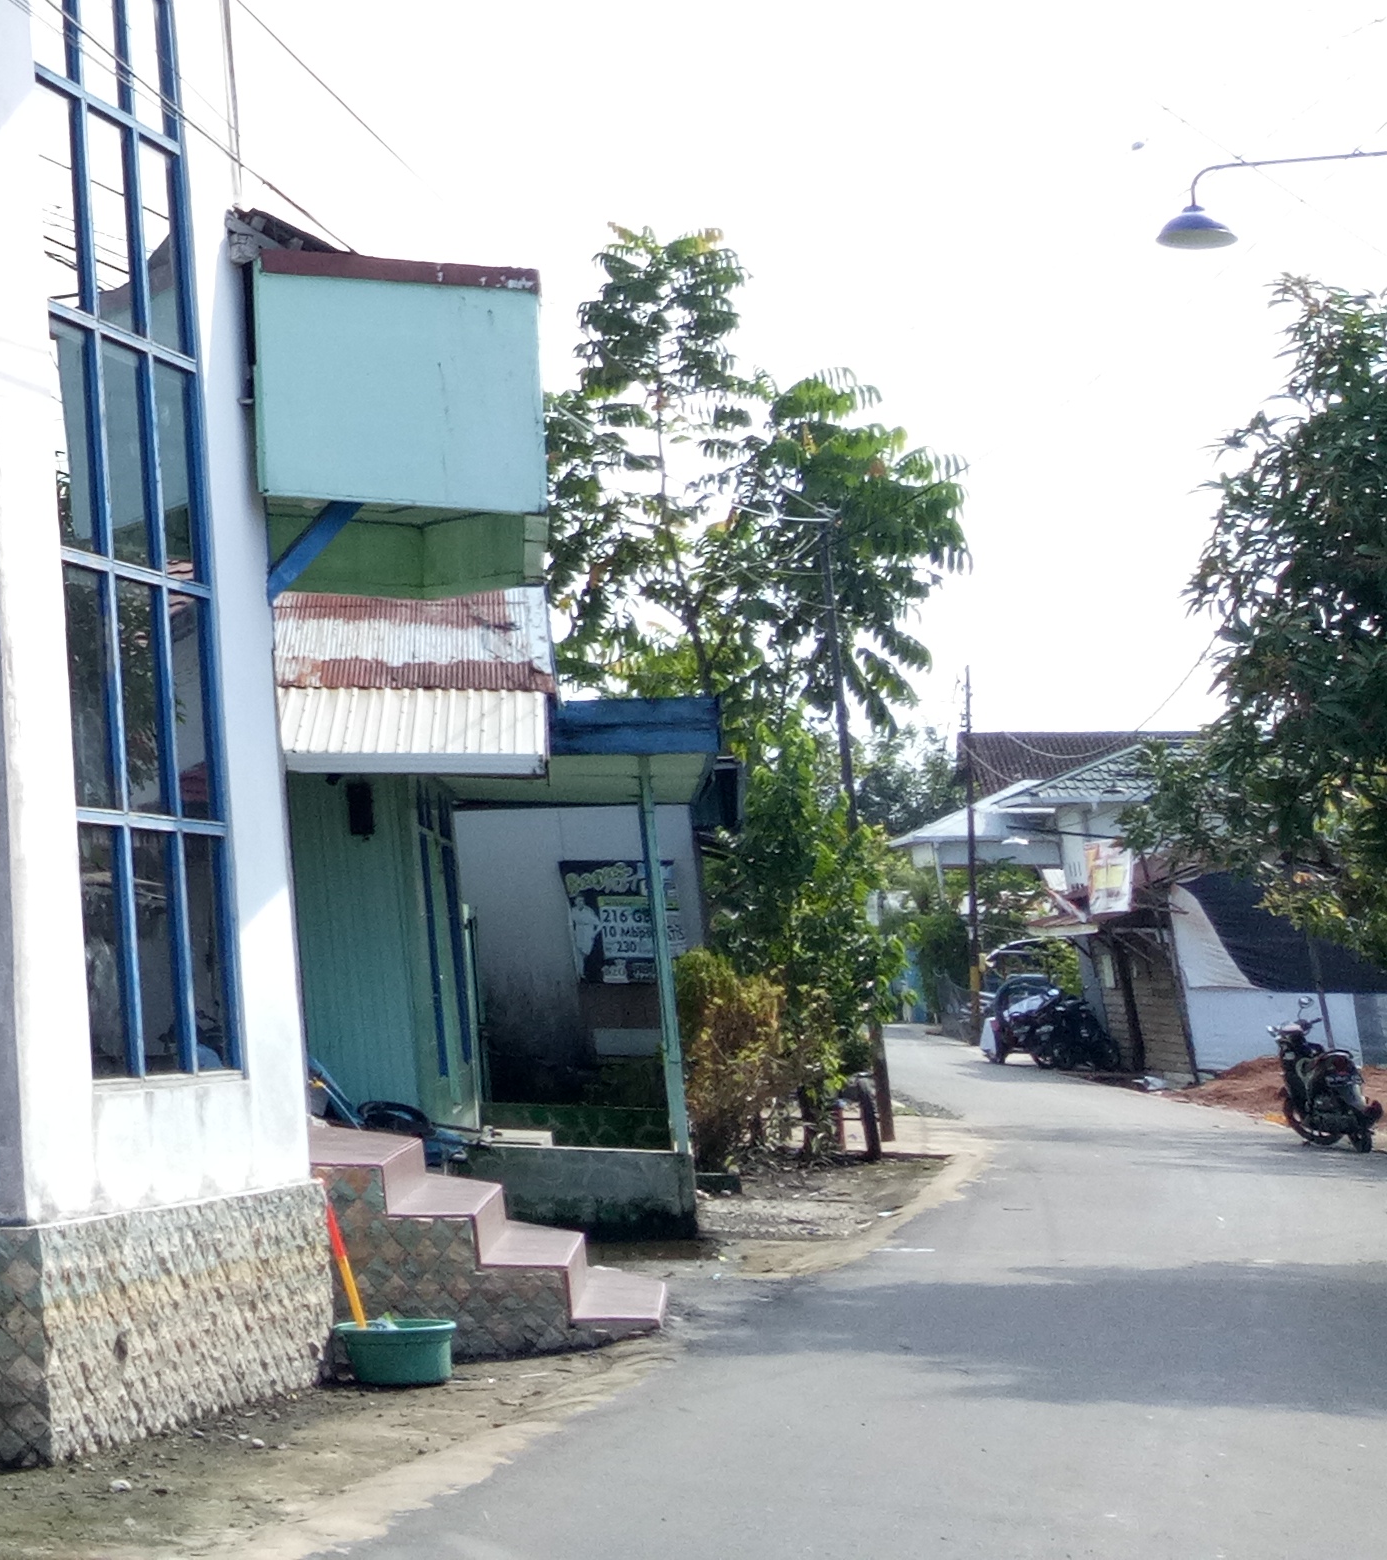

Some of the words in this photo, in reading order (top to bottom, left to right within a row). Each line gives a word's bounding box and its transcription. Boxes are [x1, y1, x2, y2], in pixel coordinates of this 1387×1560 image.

[602, 909, 628, 923] 216
[602, 926, 616, 938] 10
[616, 941, 637, 953] 230
